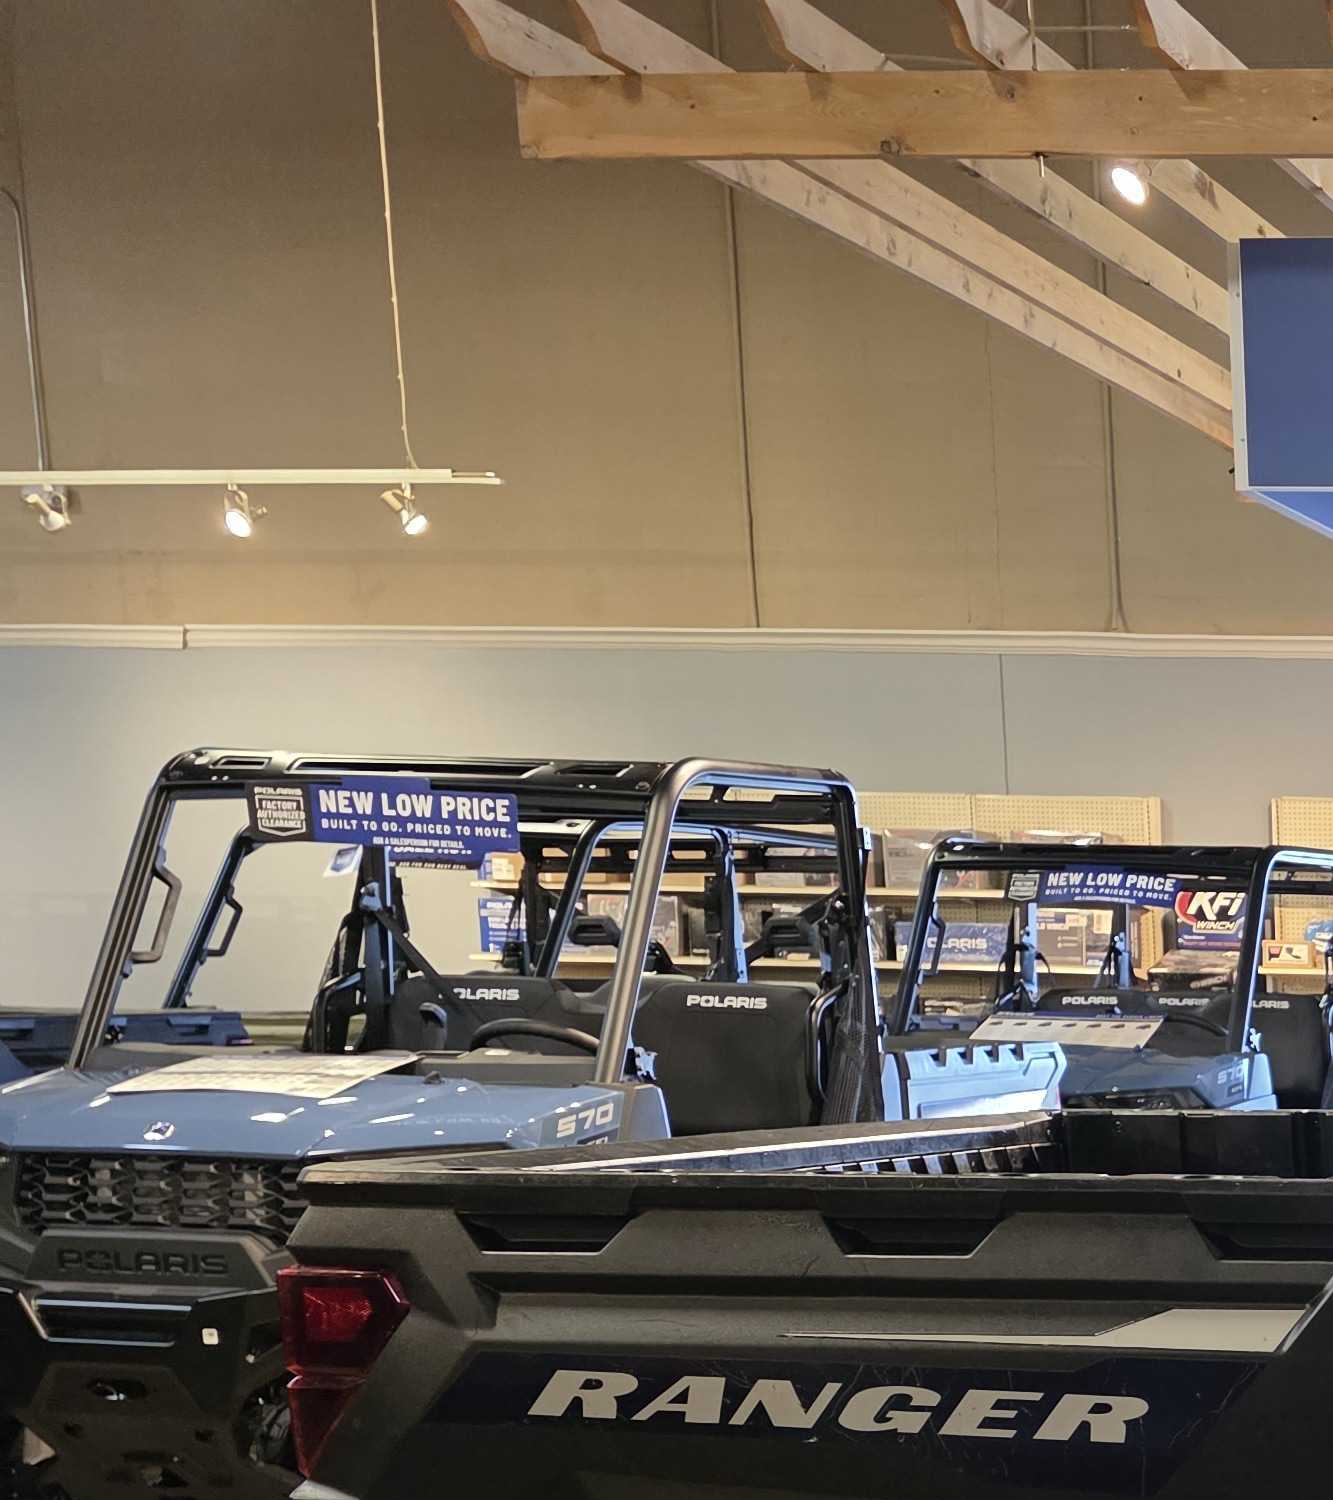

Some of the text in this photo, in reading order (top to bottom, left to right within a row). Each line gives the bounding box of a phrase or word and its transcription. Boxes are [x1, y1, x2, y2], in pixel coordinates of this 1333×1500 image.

[318, 789, 512, 822] NEW LOW PRICE
[321, 818, 359, 830] BUILT
[362, 820, 378, 831] TO
[406, 822, 451, 835] PRICED
[455, 825, 471, 837] TO
[474, 826, 512, 839] MOVE.
[1047, 872, 1084, 887] NEW
[1086, 873, 1124, 887] LOW
[1126, 874, 1177, 892] PRICE
[1195, 920, 1236, 930] WINCH
[686, 994, 768, 1010] POLARIS
[1062, 995, 1118, 1006] POLARIS
[1252, 1000, 1290, 1009] LARIS
[556, 1103, 615, 1139] 570
[57, 1249, 229, 1276] POLARIS
[526, 1368, 1150, 1445] RANGER
